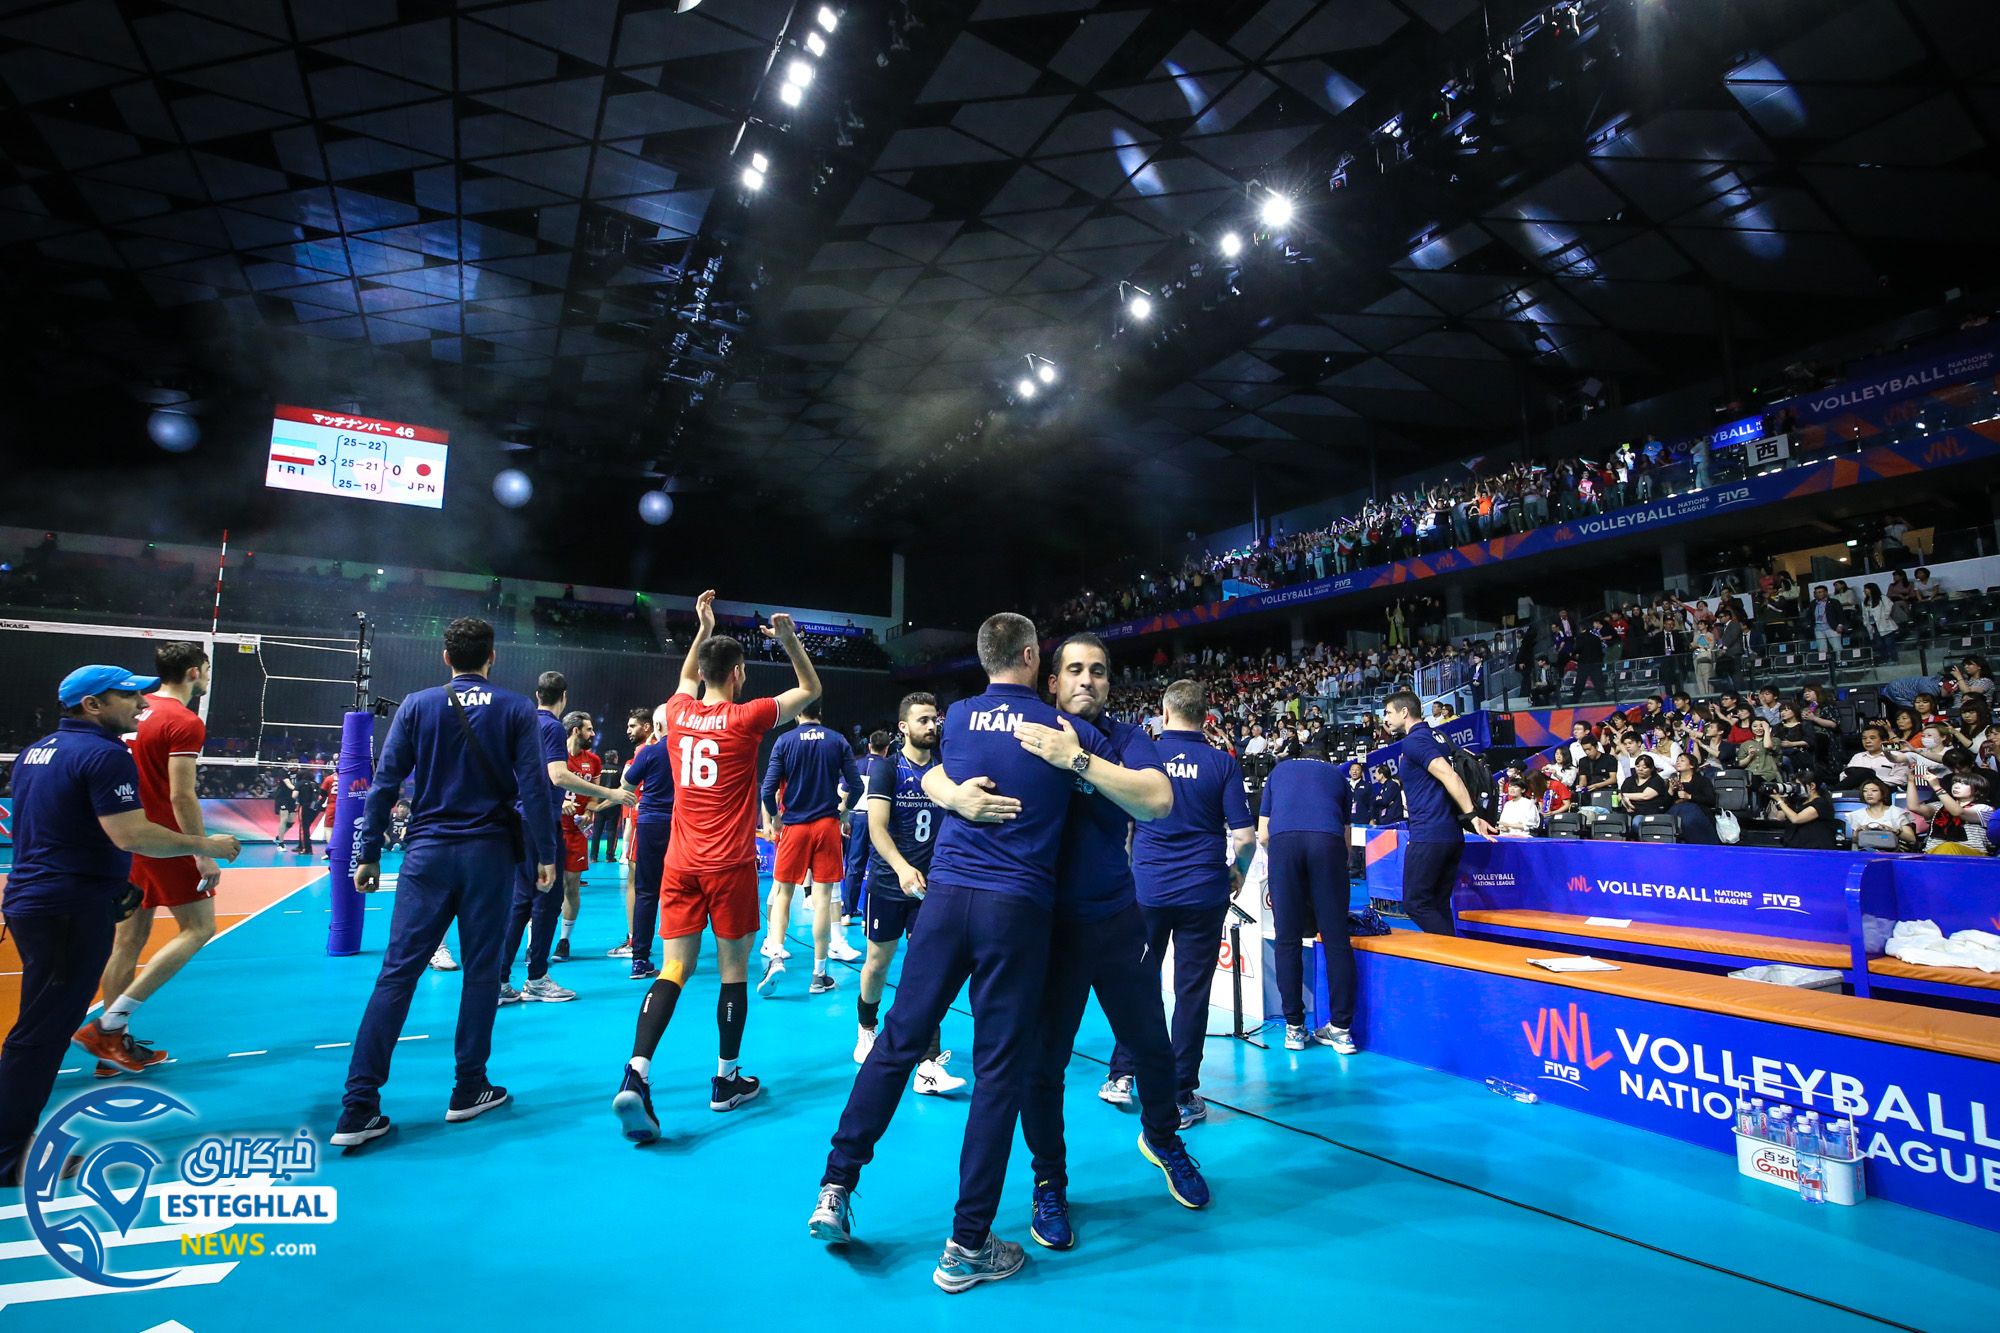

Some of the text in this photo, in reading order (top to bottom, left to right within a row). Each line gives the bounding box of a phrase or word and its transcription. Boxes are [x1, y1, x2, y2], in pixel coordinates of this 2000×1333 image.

[1947, 352, 1994, 369] NATIONS
[1948, 360, 1989, 376] LEAGUE
[1810, 367, 1944, 412] VOLLEYBALL
[312, 413, 415, 438] マッチナンバー 46
[1923, 436, 1968, 463] VNL
[317, 455, 327, 466] 3
[392, 465, 401, 476] 0
[278, 464, 436, 493] IRI JPN
[1677, 496, 1710, 508] NATIONS
[1718, 487, 1750, 503] FIVB
[1678, 503, 1707, 515] LEAGUE
[1579, 505, 1676, 535] VOLLEYBALL
[1334, 578, 1351, 589] FIVB
[1261, 588, 1313, 606] VOLLEYBALL
[969, 711, 1024, 732] IRAN
[800, 731, 825, 741] IRAN
[1450, 728, 1474, 745] FIVB
[23, 748, 57, 765] IRAN
[678, 735, 720, 788] 16
[114, 783, 135, 797] VNL
[914, 809, 932, 842] 8
[1472, 873, 1515, 881] VOLLEYBALL
[1567, 875, 1712, 903] VNL VOLLEYBALL
[1714, 889, 1752, 899] NATIONS
[1714, 896, 1749, 906] LEAGUE
[1762, 893, 1800, 907] FIVB
[873, 918, 879, 930] 8
[1521, 1002, 1614, 1071] VNL
[1543, 1060, 1581, 1081] FIVB
[1615, 1027, 2000, 1151] VOLLEYBALL
[1619, 1069, 1740, 1120] NATIO
[1866, 1131, 2000, 1193] AGUE
